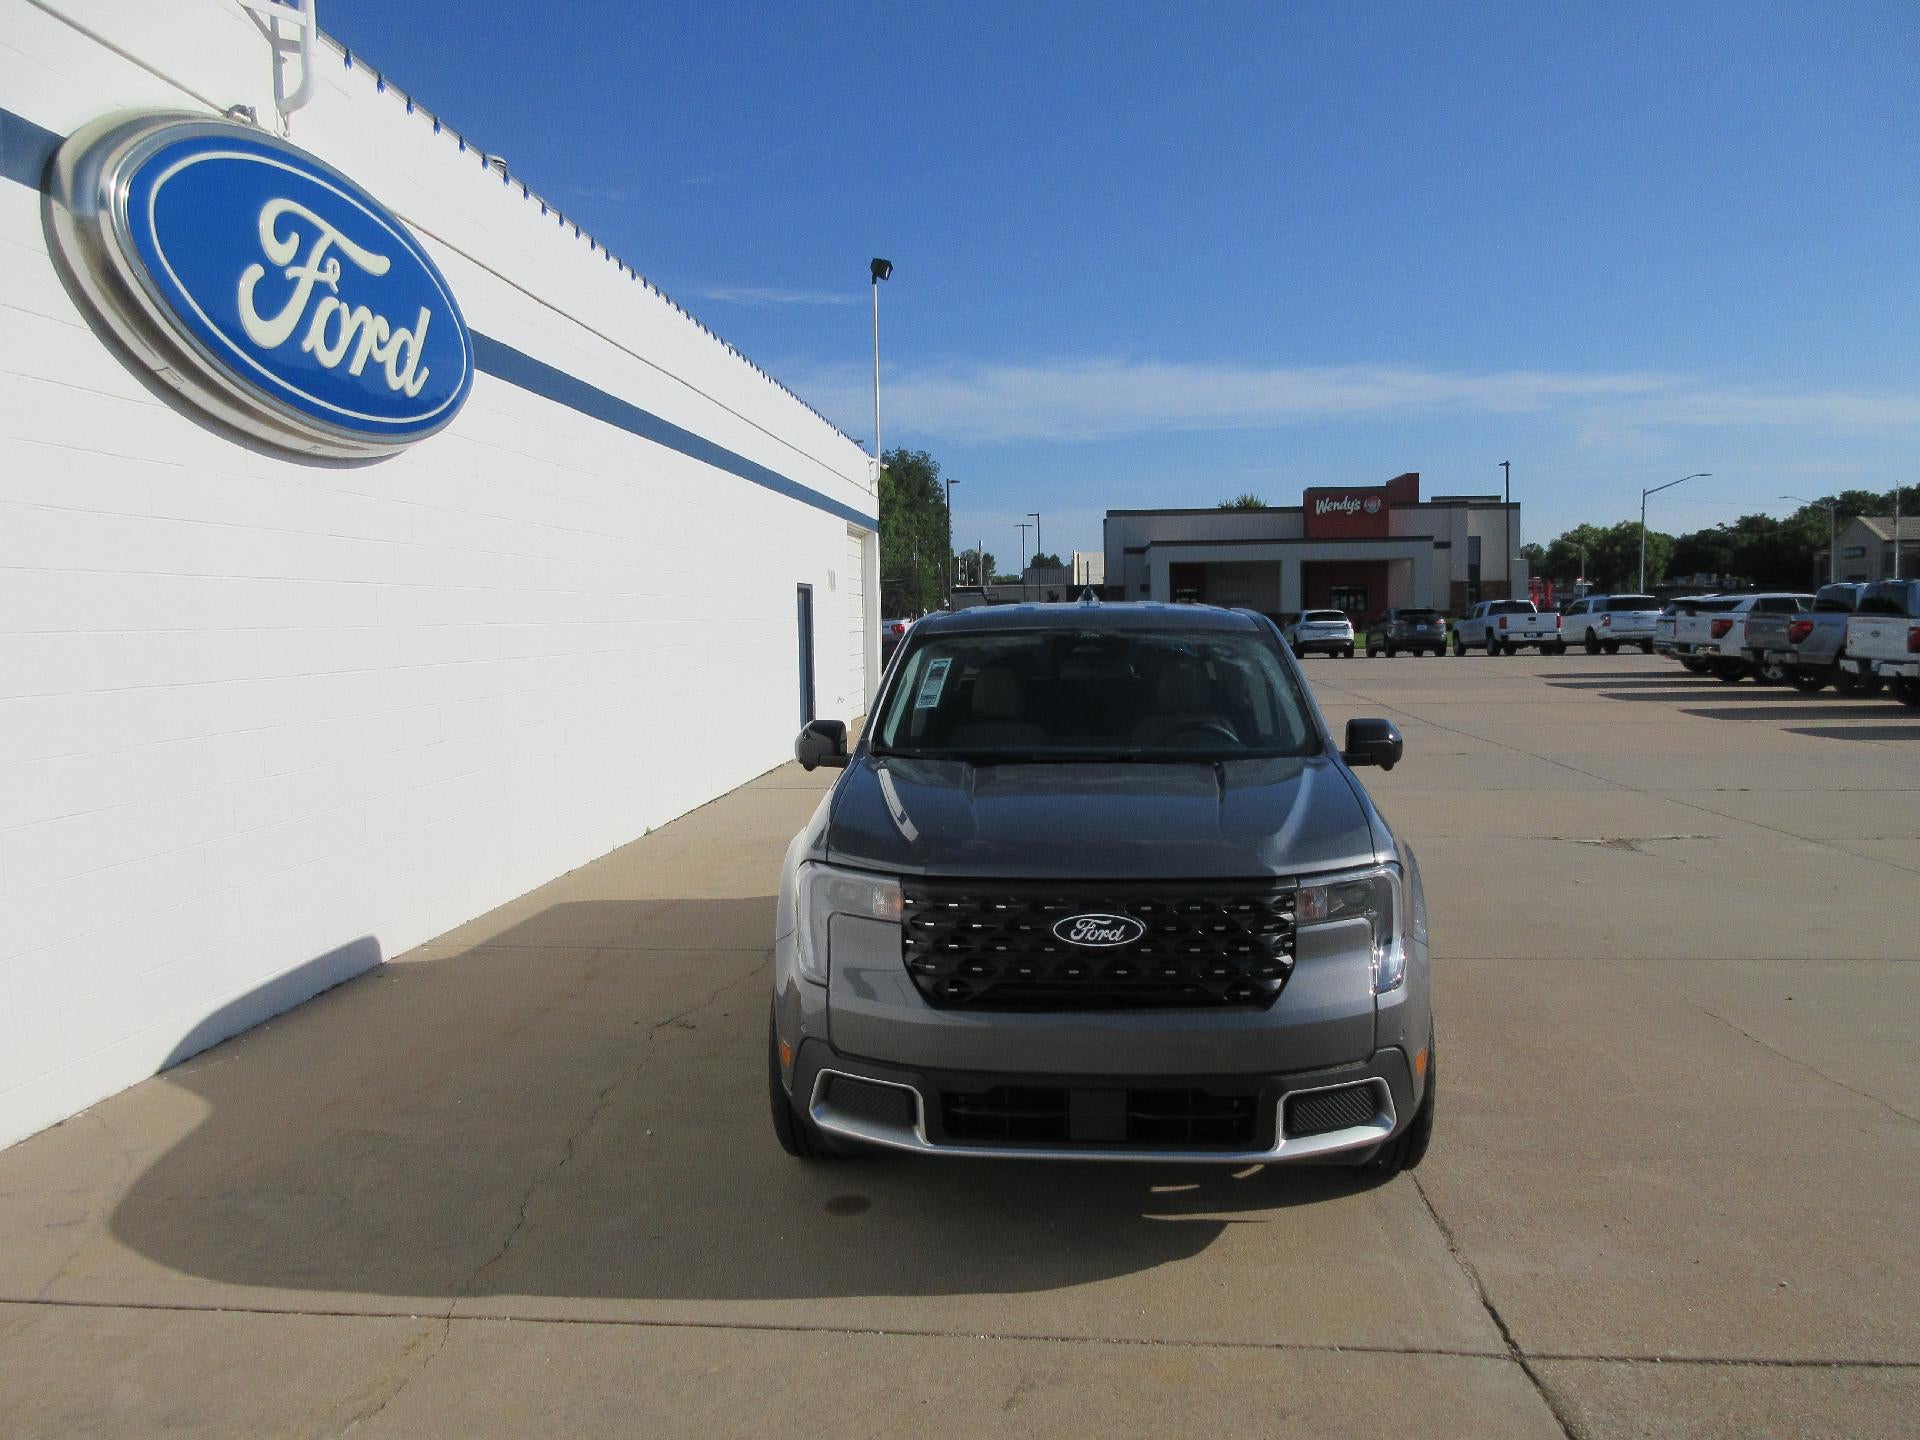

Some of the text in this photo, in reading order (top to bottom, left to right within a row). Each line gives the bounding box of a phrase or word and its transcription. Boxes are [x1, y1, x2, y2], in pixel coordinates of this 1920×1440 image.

[237, 198, 431, 398] Ford
[1315, 495, 1361, 516] Wendy's
[1070, 918, 1126, 941] Ford
